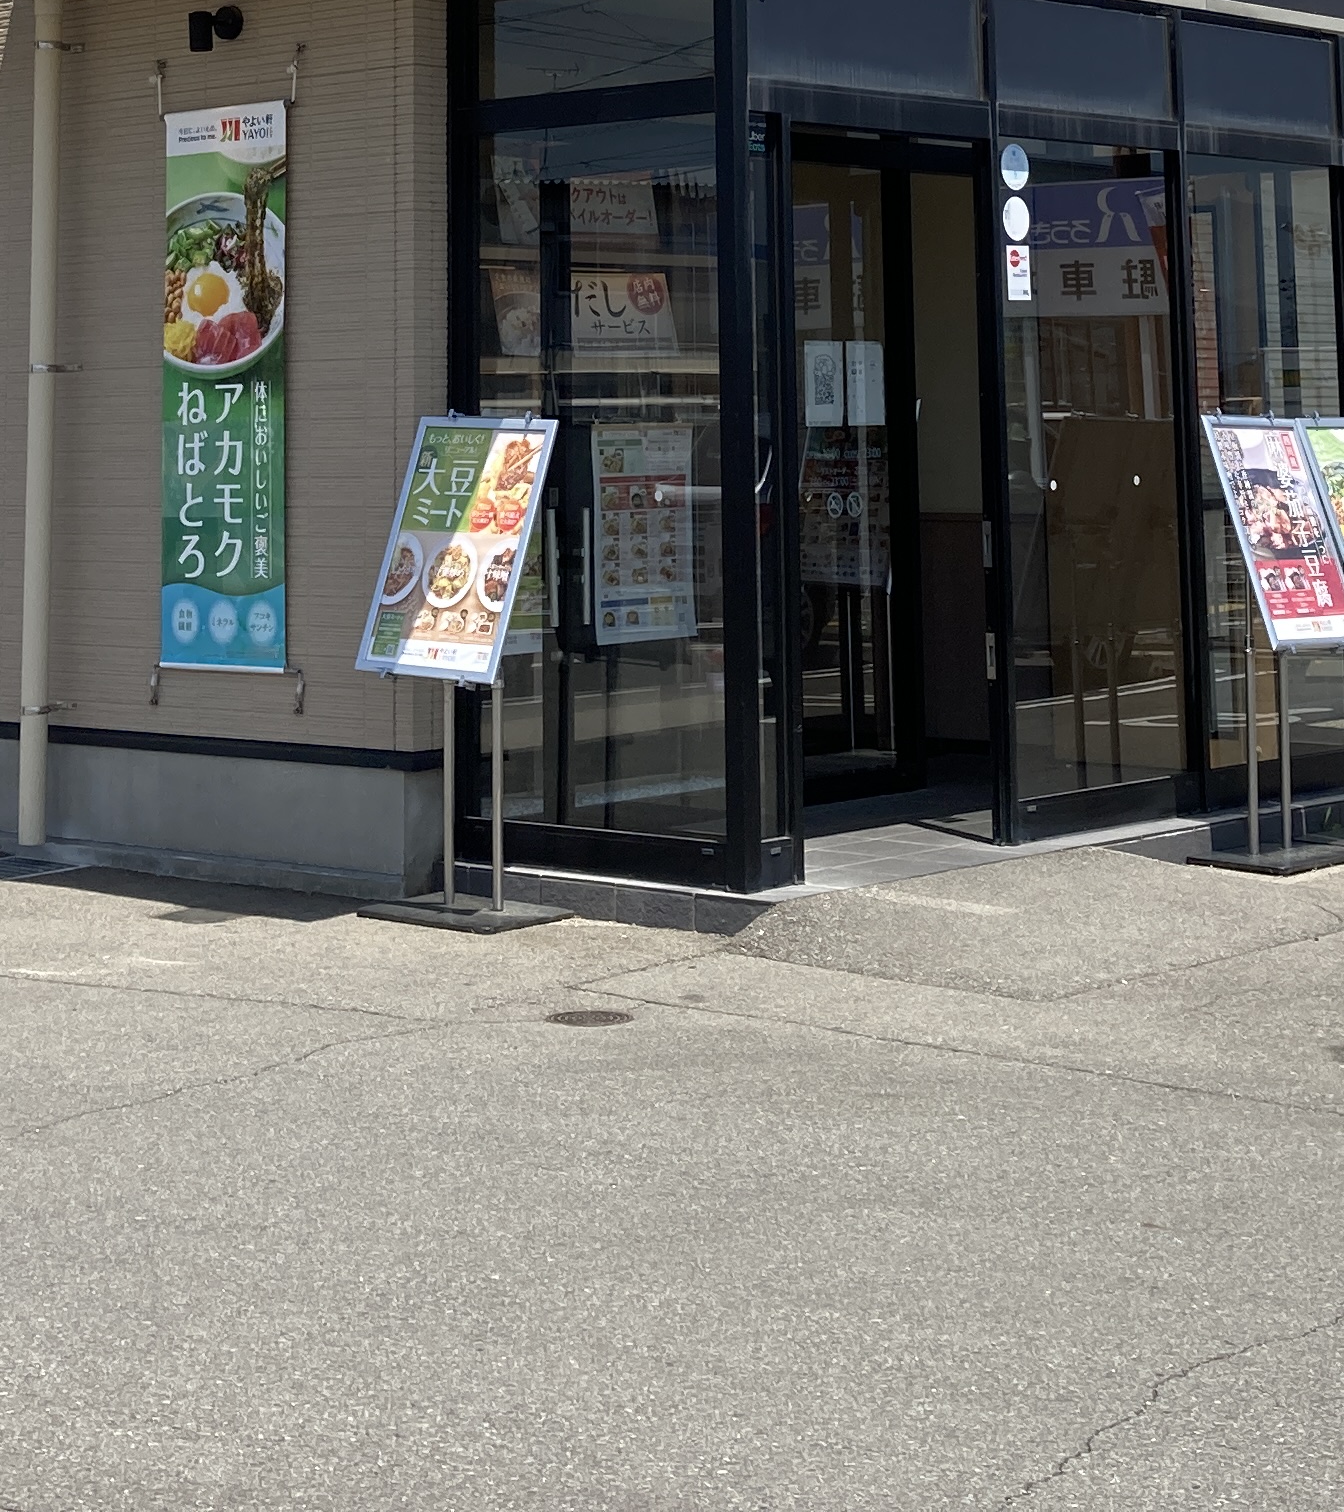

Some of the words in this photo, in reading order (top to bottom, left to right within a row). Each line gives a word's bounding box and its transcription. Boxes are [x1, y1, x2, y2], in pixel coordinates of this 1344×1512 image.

[242, 114, 273, 127] やよい軒
[242, 127, 269, 141] YAYOI
[571, 280, 627, 318] だし
[633, 277, 654, 294] 店内
[591, 319, 650, 335] サービス
[177, 382, 208, 578] ねばとろ
[214, 384, 243, 577] アカモク
[255, 381, 268, 579] 体においしいご褒美
[413, 458, 479, 496] 大豆
[413, 498, 462, 528] ミート
